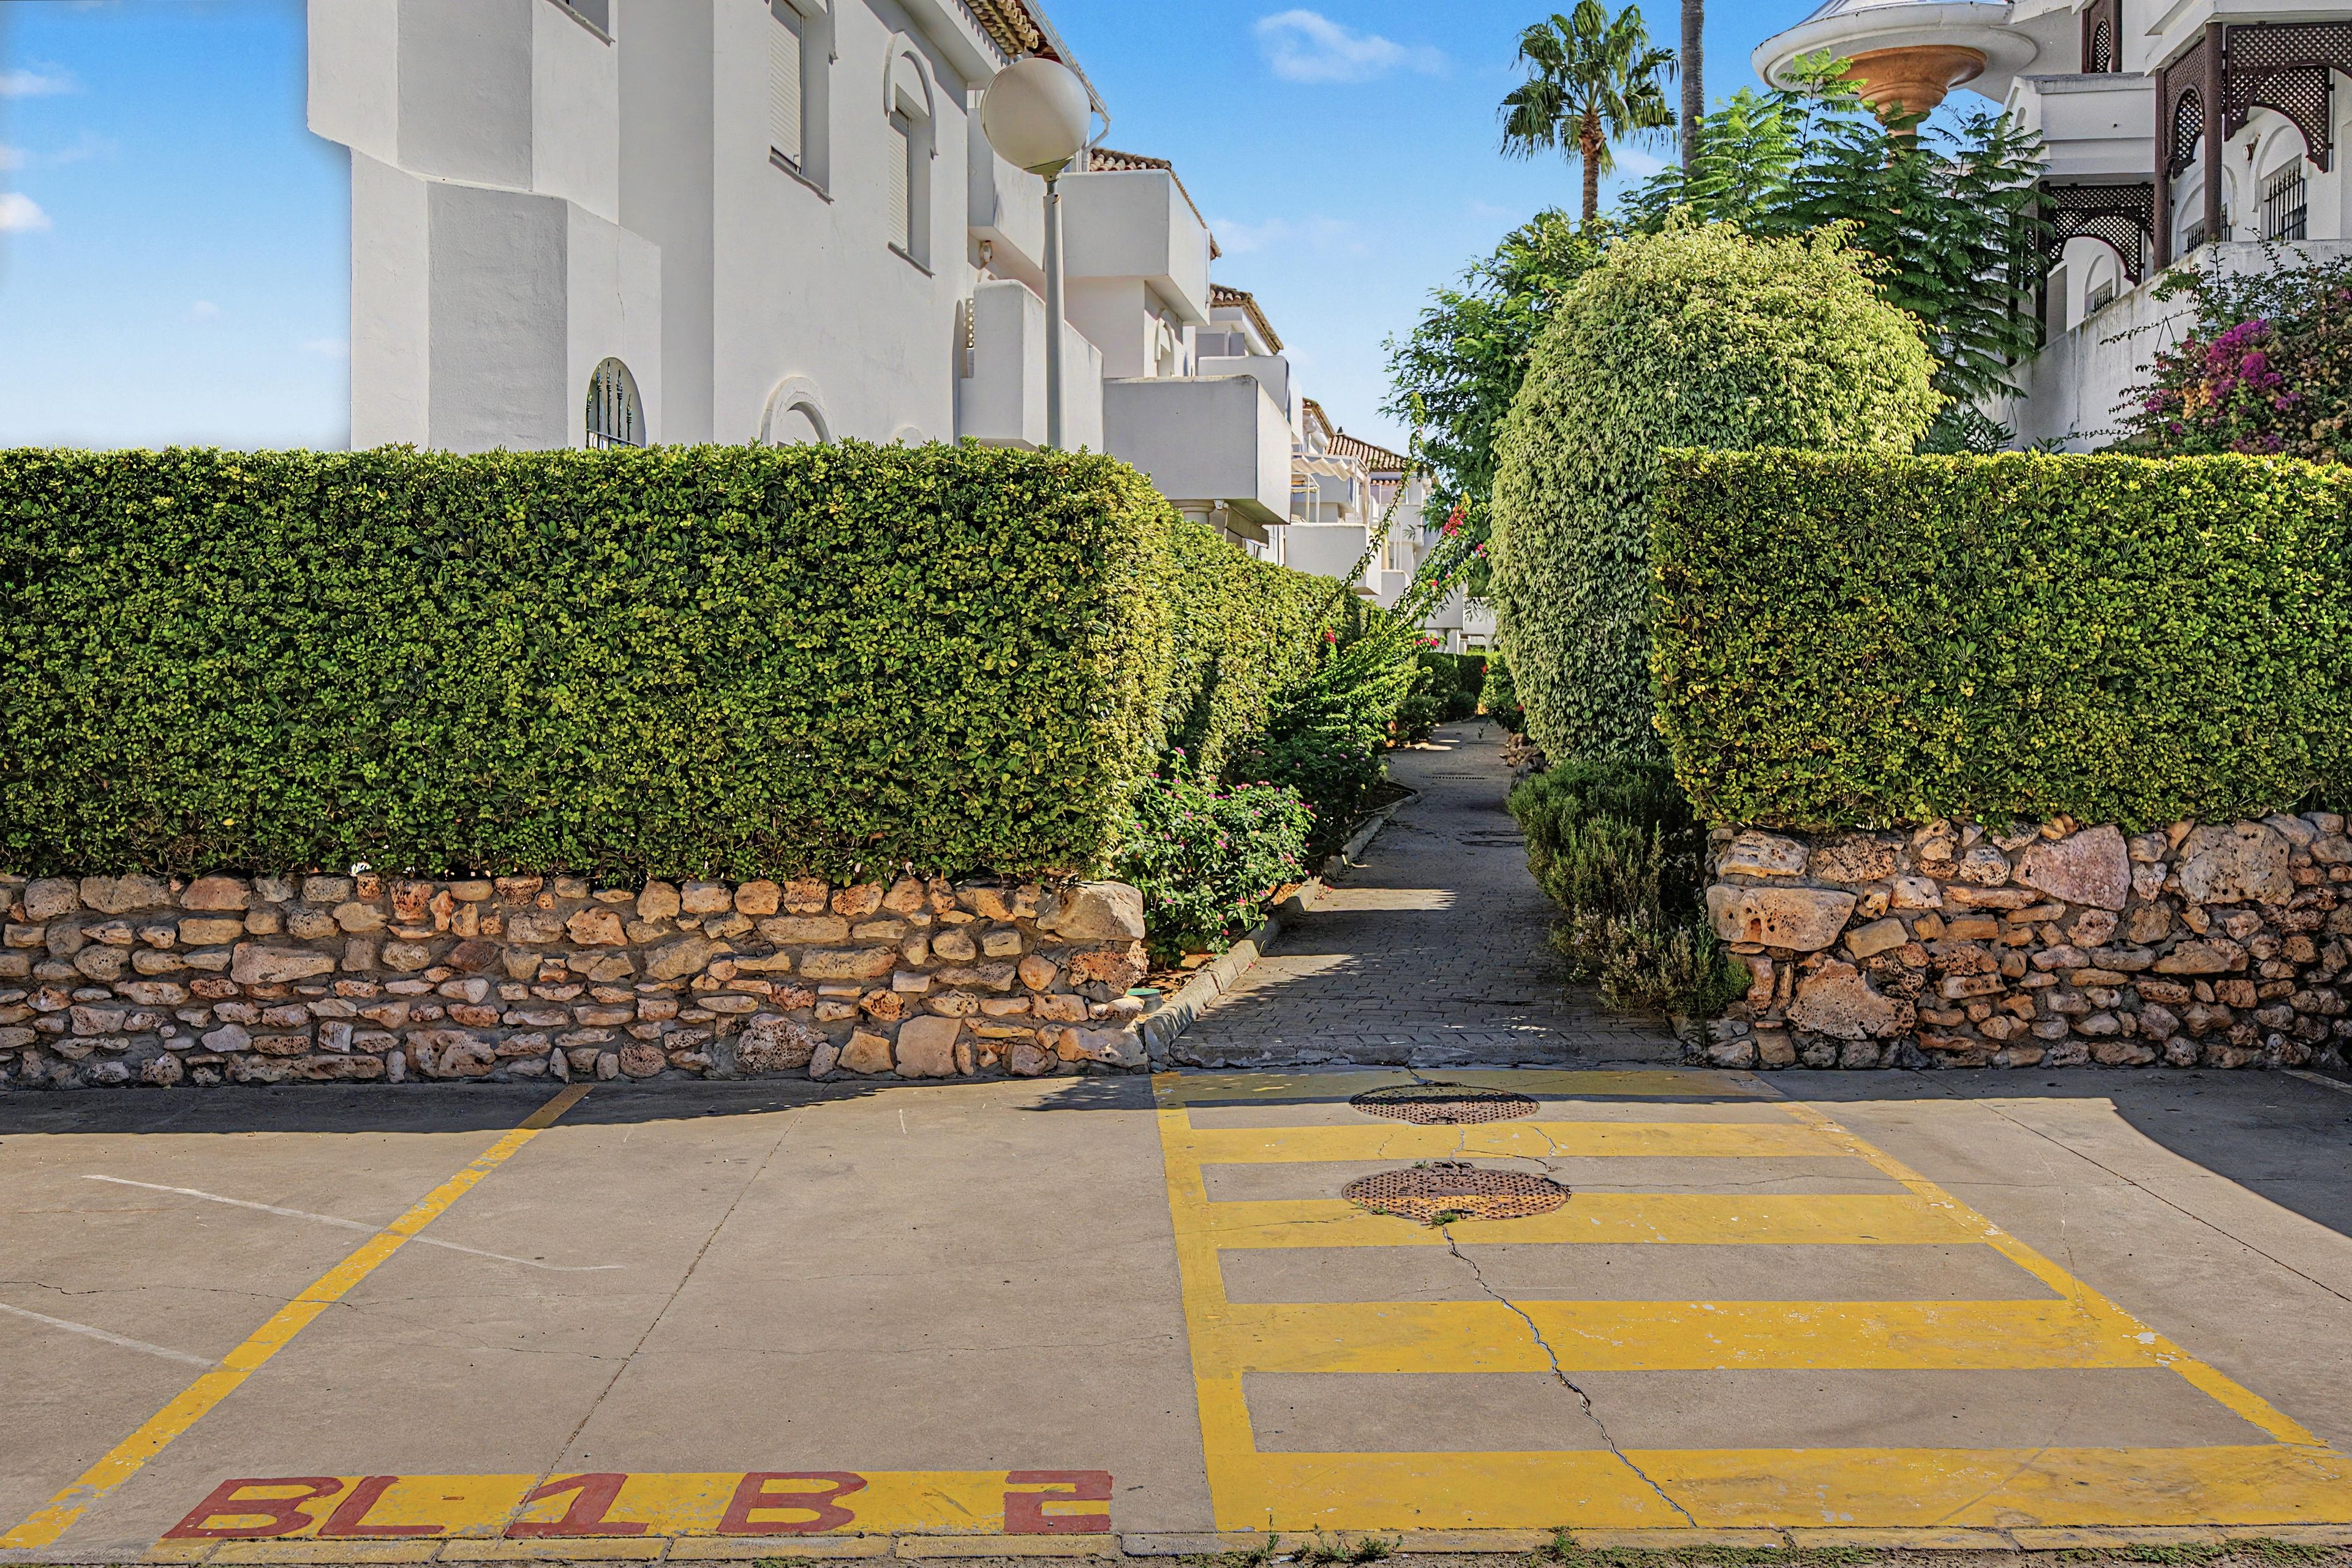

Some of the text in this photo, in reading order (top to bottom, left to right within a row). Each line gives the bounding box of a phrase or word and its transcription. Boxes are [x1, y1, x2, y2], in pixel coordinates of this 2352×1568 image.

[162, 1470, 1114, 1538] BL 1 B 2
